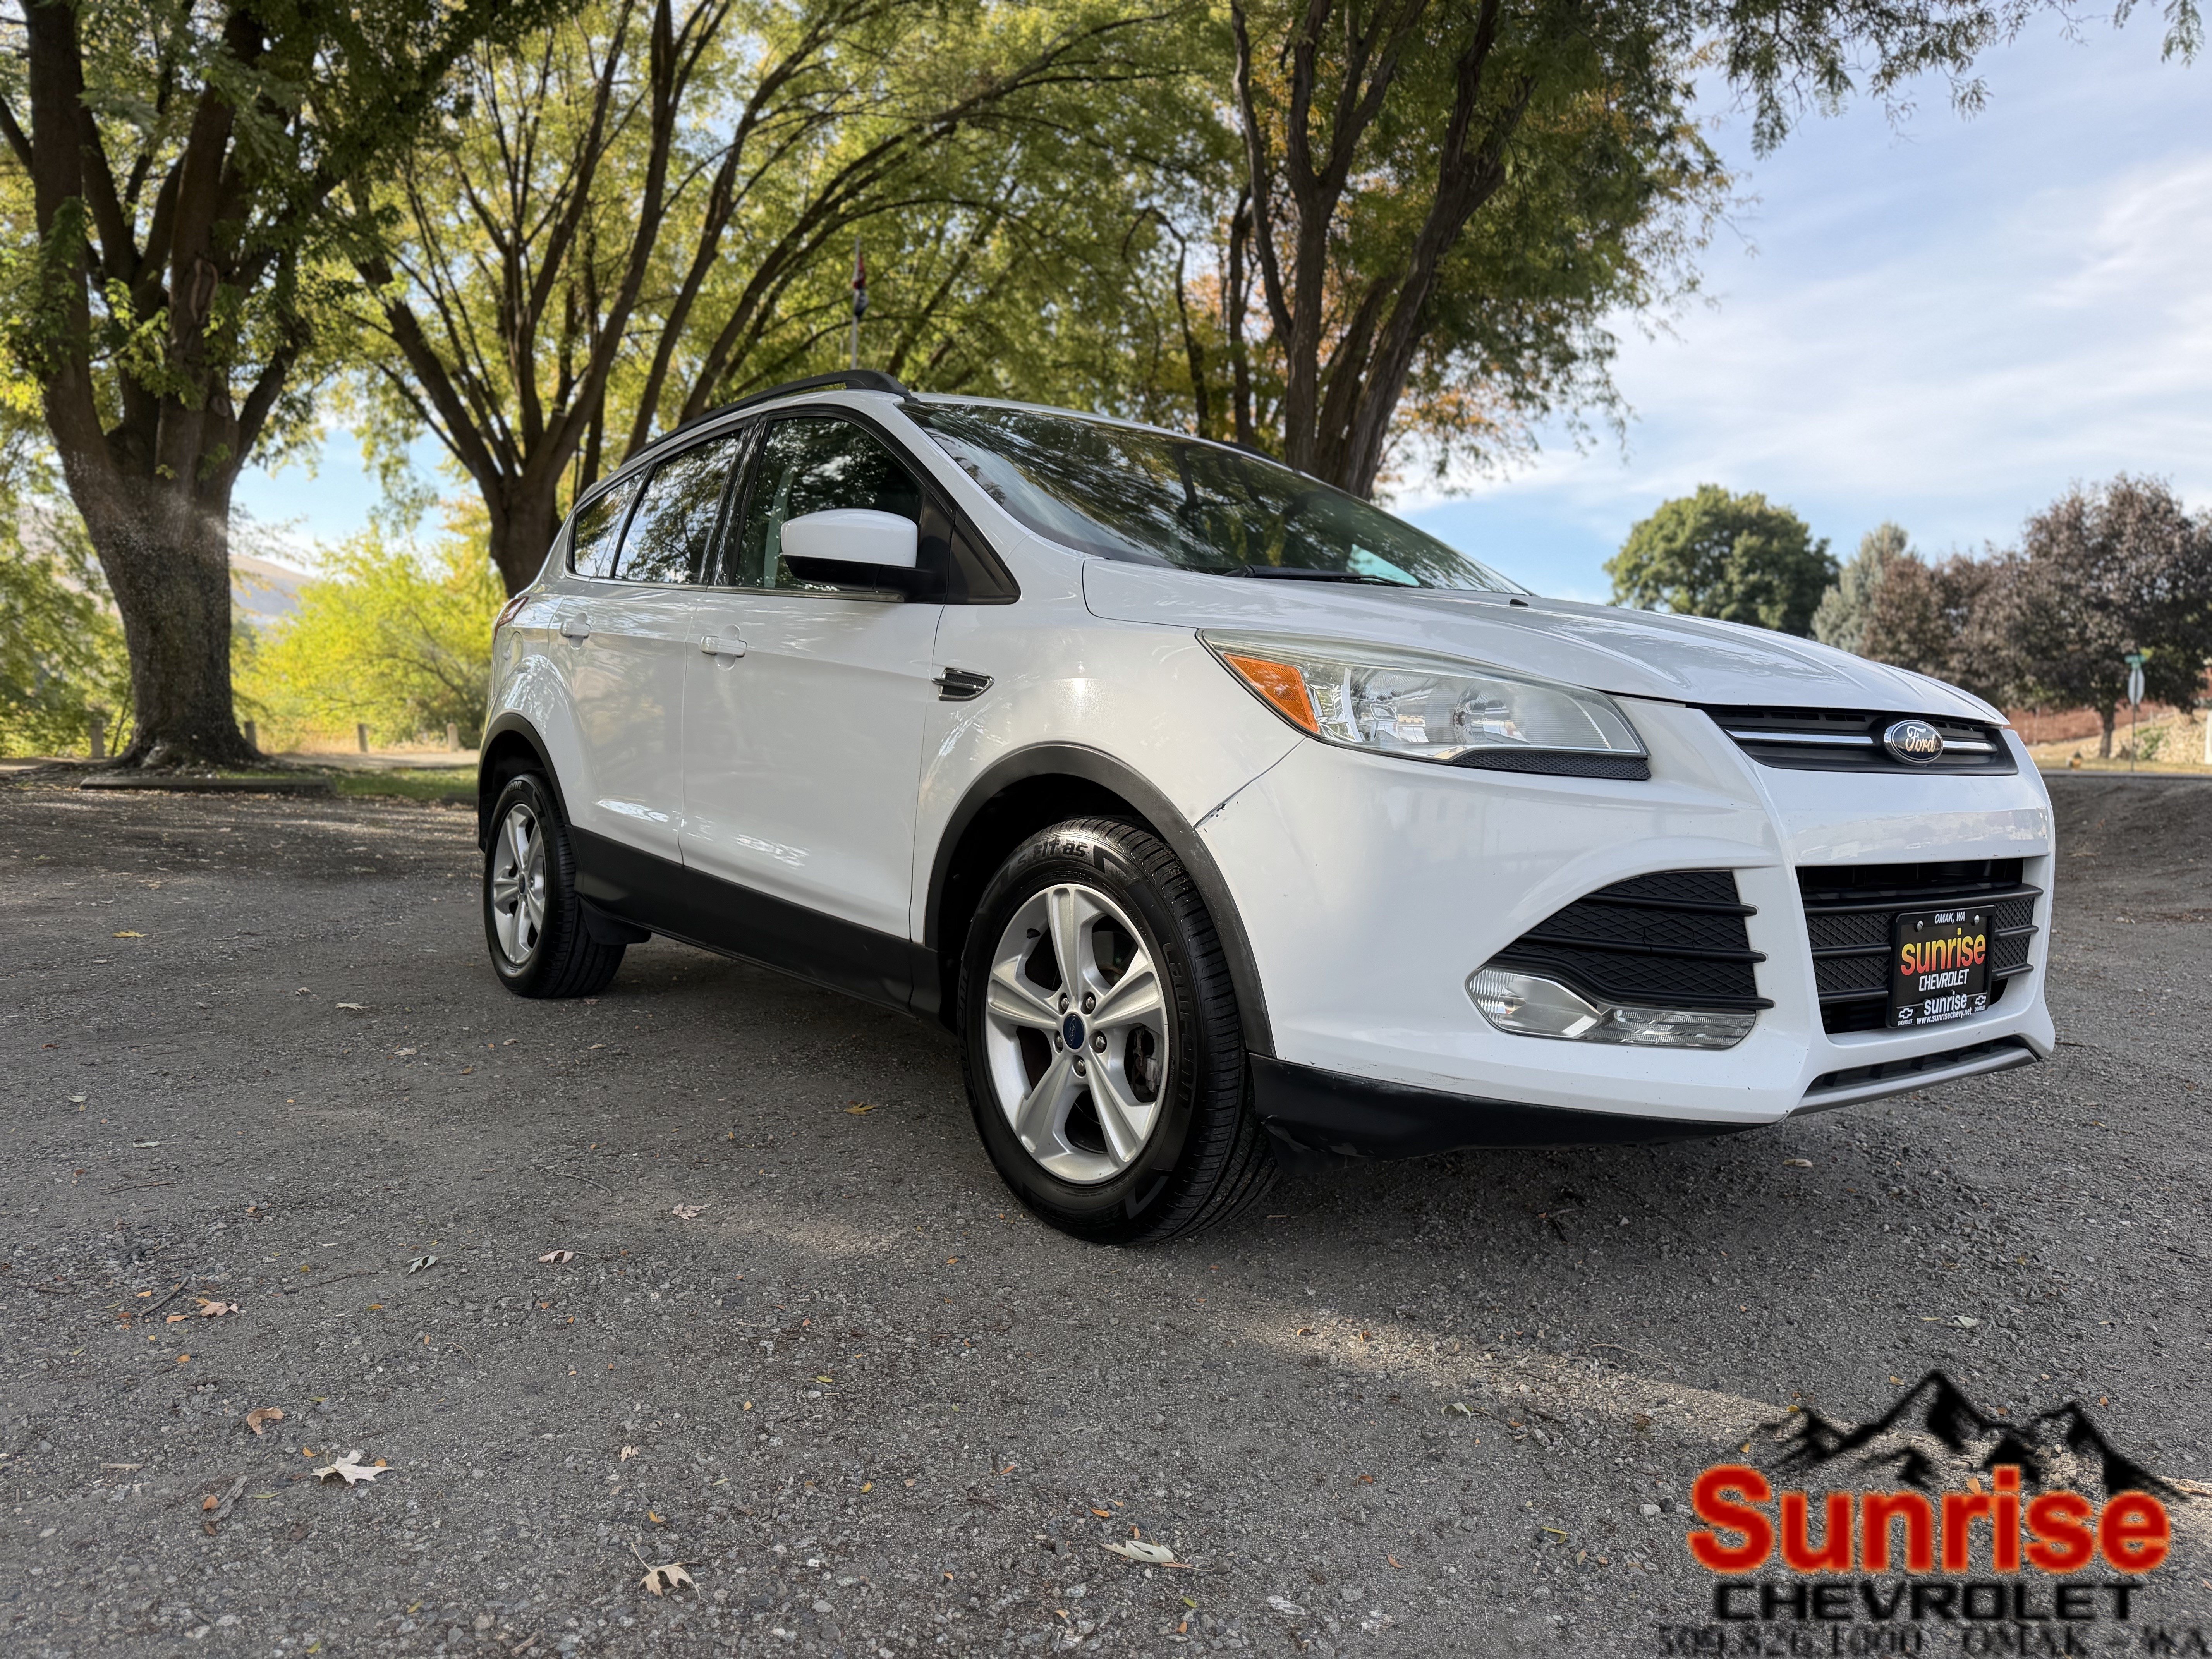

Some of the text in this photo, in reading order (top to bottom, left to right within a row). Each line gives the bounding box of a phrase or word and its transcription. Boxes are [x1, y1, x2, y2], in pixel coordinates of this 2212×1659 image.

[1905, 726, 1936, 752] Ford
[1935, 911, 1965, 924] OMAK, WA
[1901, 928, 1986, 975] sunrise
[1919, 969, 1969, 991] CHEVROLET
[1923, 990, 1967, 1015] sunrise
[1917, 1007, 1972, 1025] www.sunrisechevy.net
